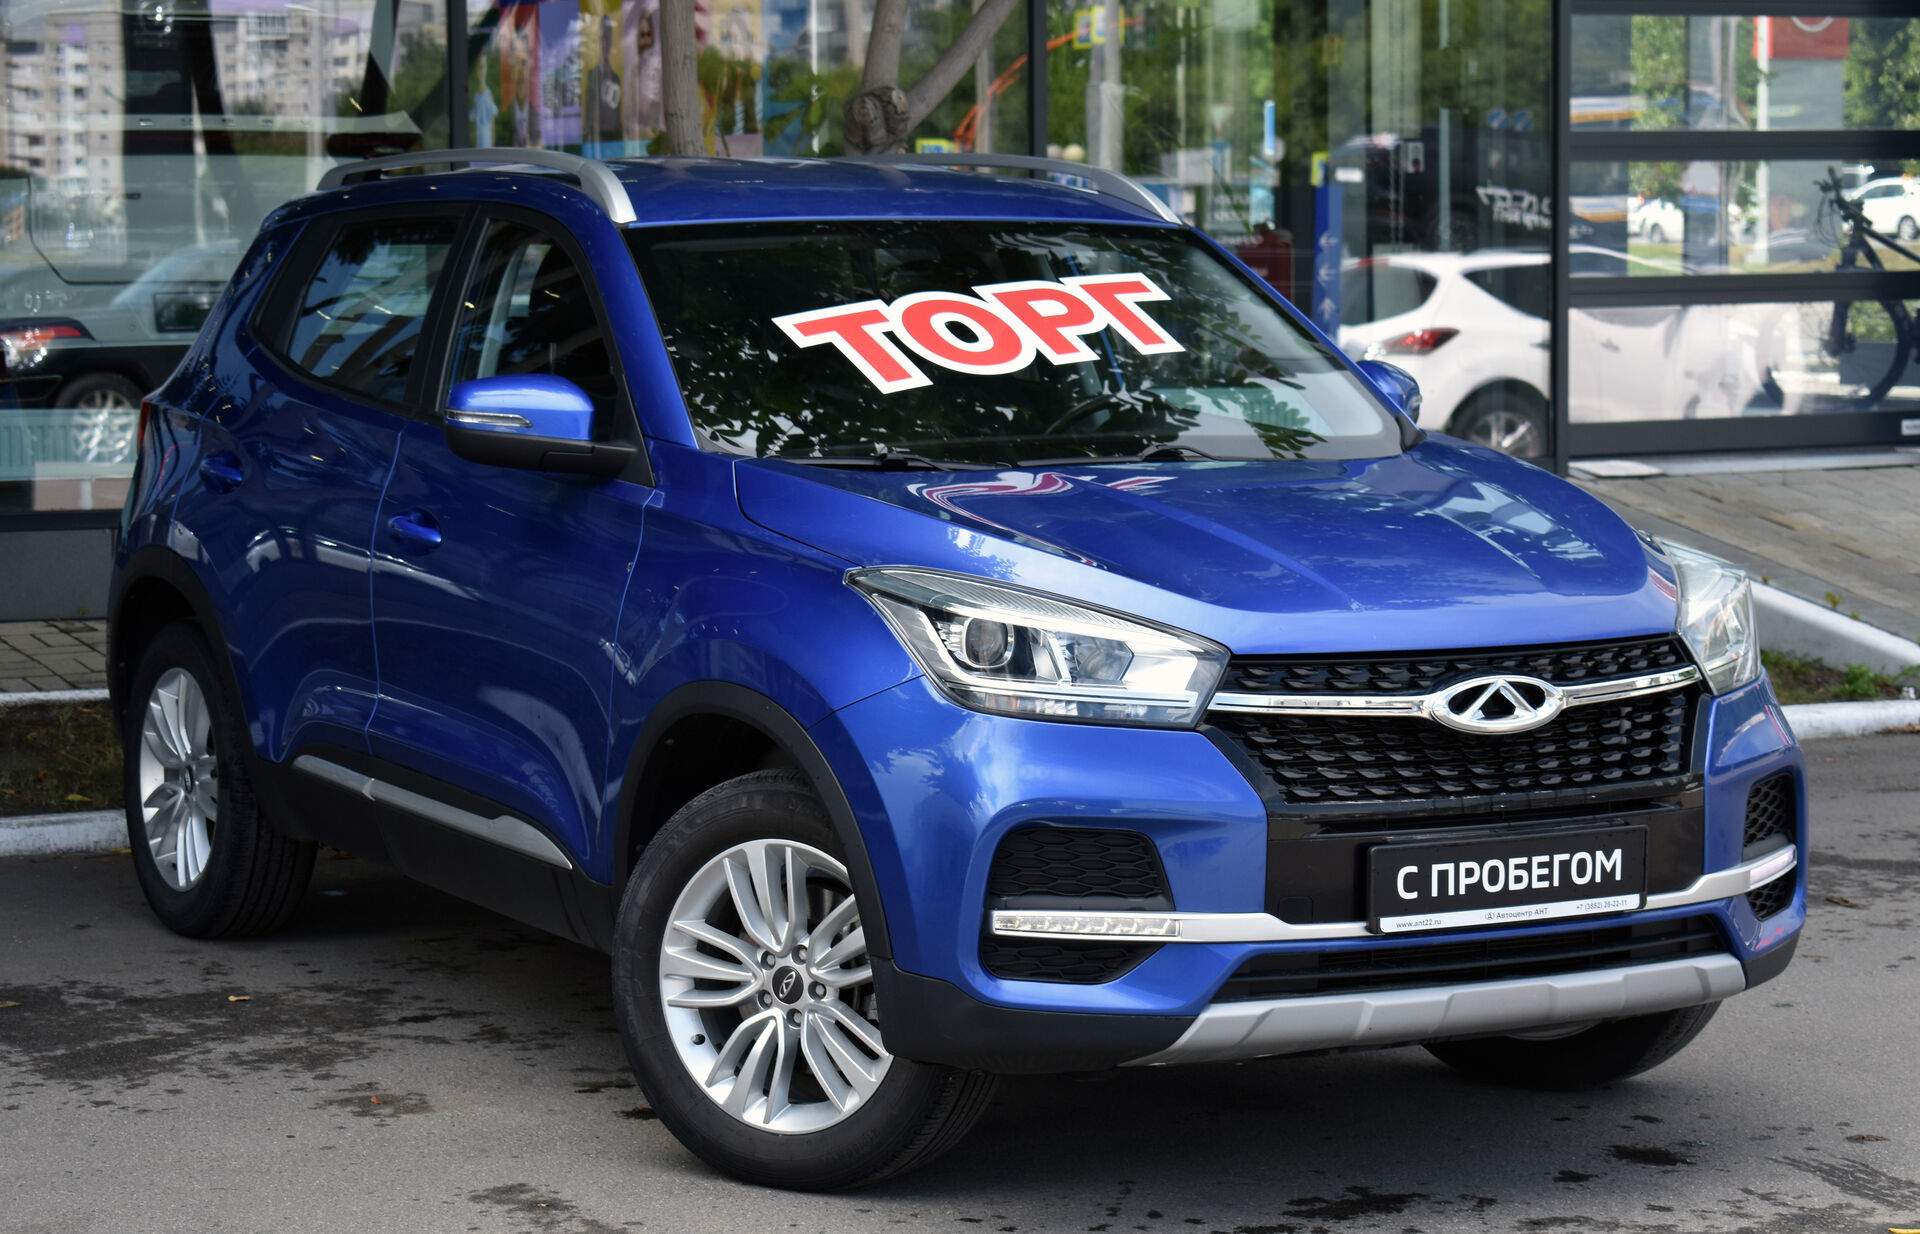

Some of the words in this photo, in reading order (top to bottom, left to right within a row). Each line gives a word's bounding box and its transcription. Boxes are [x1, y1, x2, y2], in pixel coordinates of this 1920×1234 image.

[774, 273, 1185, 392] ТОРГ
[1397, 865, 1418, 900] С
[1431, 848, 1622, 897] ПРОБЕГОМ
[1396, 918, 1442, 928] www.ant22.ru
[1496, 910, 1533, 919] Автоцентр
